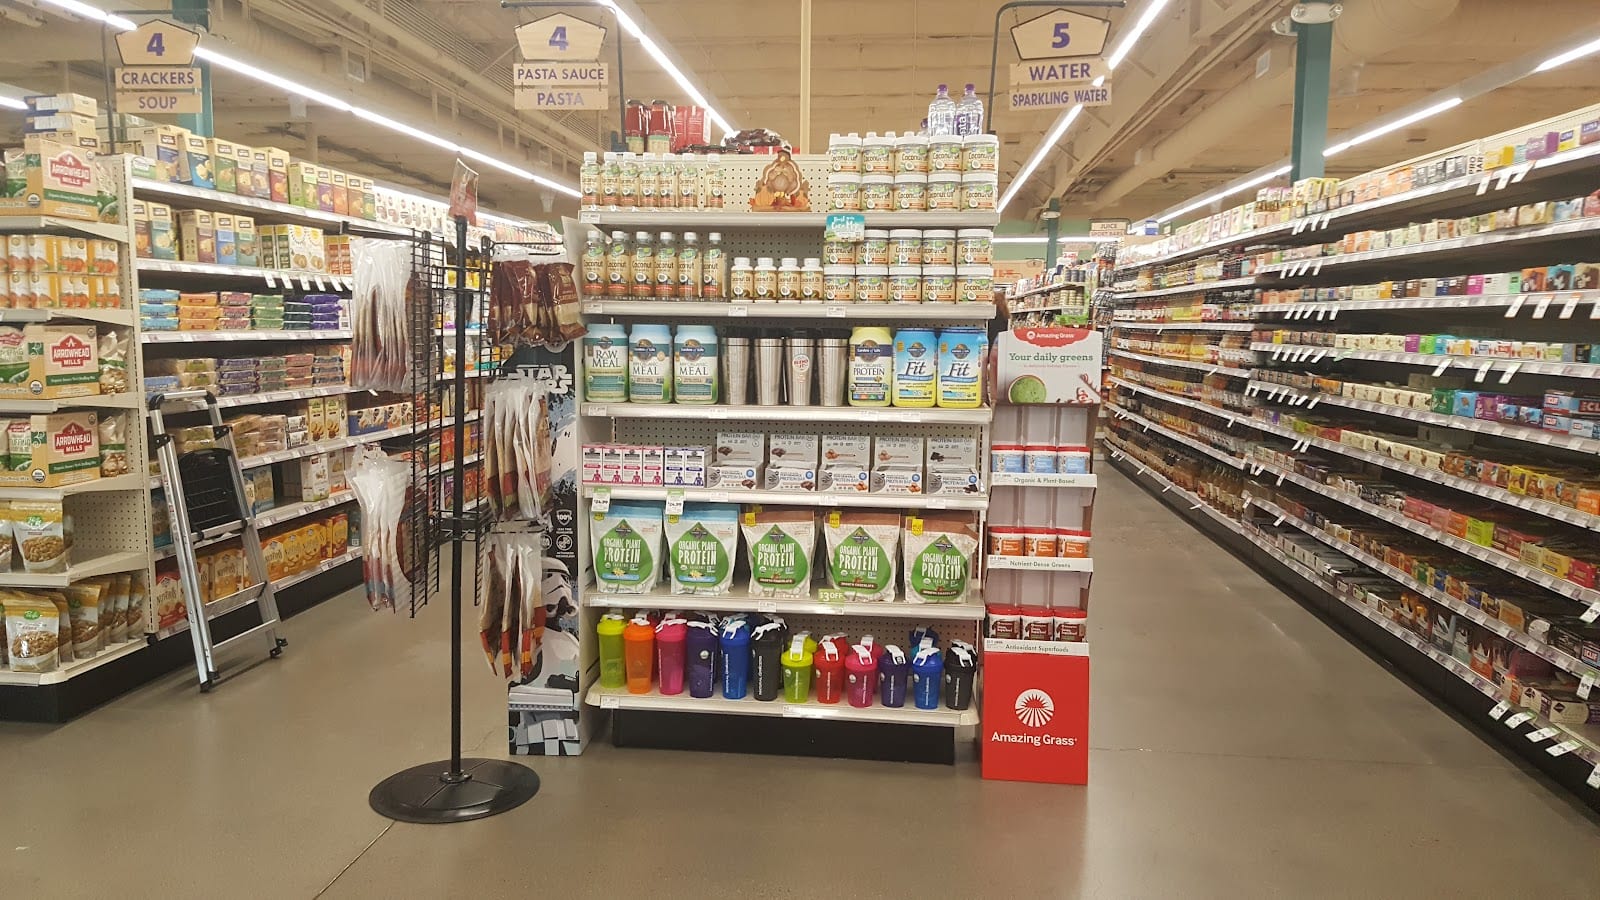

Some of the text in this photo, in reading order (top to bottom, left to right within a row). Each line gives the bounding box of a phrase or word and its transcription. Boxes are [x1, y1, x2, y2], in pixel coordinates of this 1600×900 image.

[548, 26, 569, 51] 4
[1051, 22, 1071, 49] 5
[146, 32, 166, 57] 4
[121, 71, 195, 85] CRACKERS
[517, 68, 605, 80] PASTA SAUCE
[1029, 62, 1091, 81] WATER
[138, 95, 178, 110] SOUP
[536, 92, 585, 106] PASTA
[1012, 88, 1108, 107] SPARKLING WATER
[53, 347, 90, 359] ARROWHEAD
[596, 349, 618, 359] RAW
[1009, 352, 1094, 363] Your daily greens
[63, 358, 82, 367] MILLS
[592, 358, 622, 368] MEAL
[905, 361, 928, 376] Fit
[507, 364, 573, 380] STAR
[633, 366, 658, 376] MEAL
[679, 366, 709, 376] MEAL
[853, 367, 885, 376] PROTEIN
[948, 363, 971, 377] Fit
[55, 433, 91, 447] ARROWHEAD
[65, 444, 84, 454] MILLS
[1014, 477, 1036, 485] Organic
[626, 538, 641, 549] PLANT
[679, 540, 717, 551] ORGANIC PLANT
[758, 543, 796, 553] ORGANIC PLANT
[604, 547, 641, 564] PROTEIN
[678, 549, 717, 566] PROTEIN
[839, 545, 879, 557] ORGANIC PLANT
[758, 552, 796, 568] PROTEIN
[839, 555, 879, 571] PROTEIN
[922, 553, 960, 565] ORGANIC PLANT
[921, 563, 961, 580] PROTEIN
[1039, 645, 1070, 653] Superfoods
[991, 731, 1075, 747] Amazing Grass
